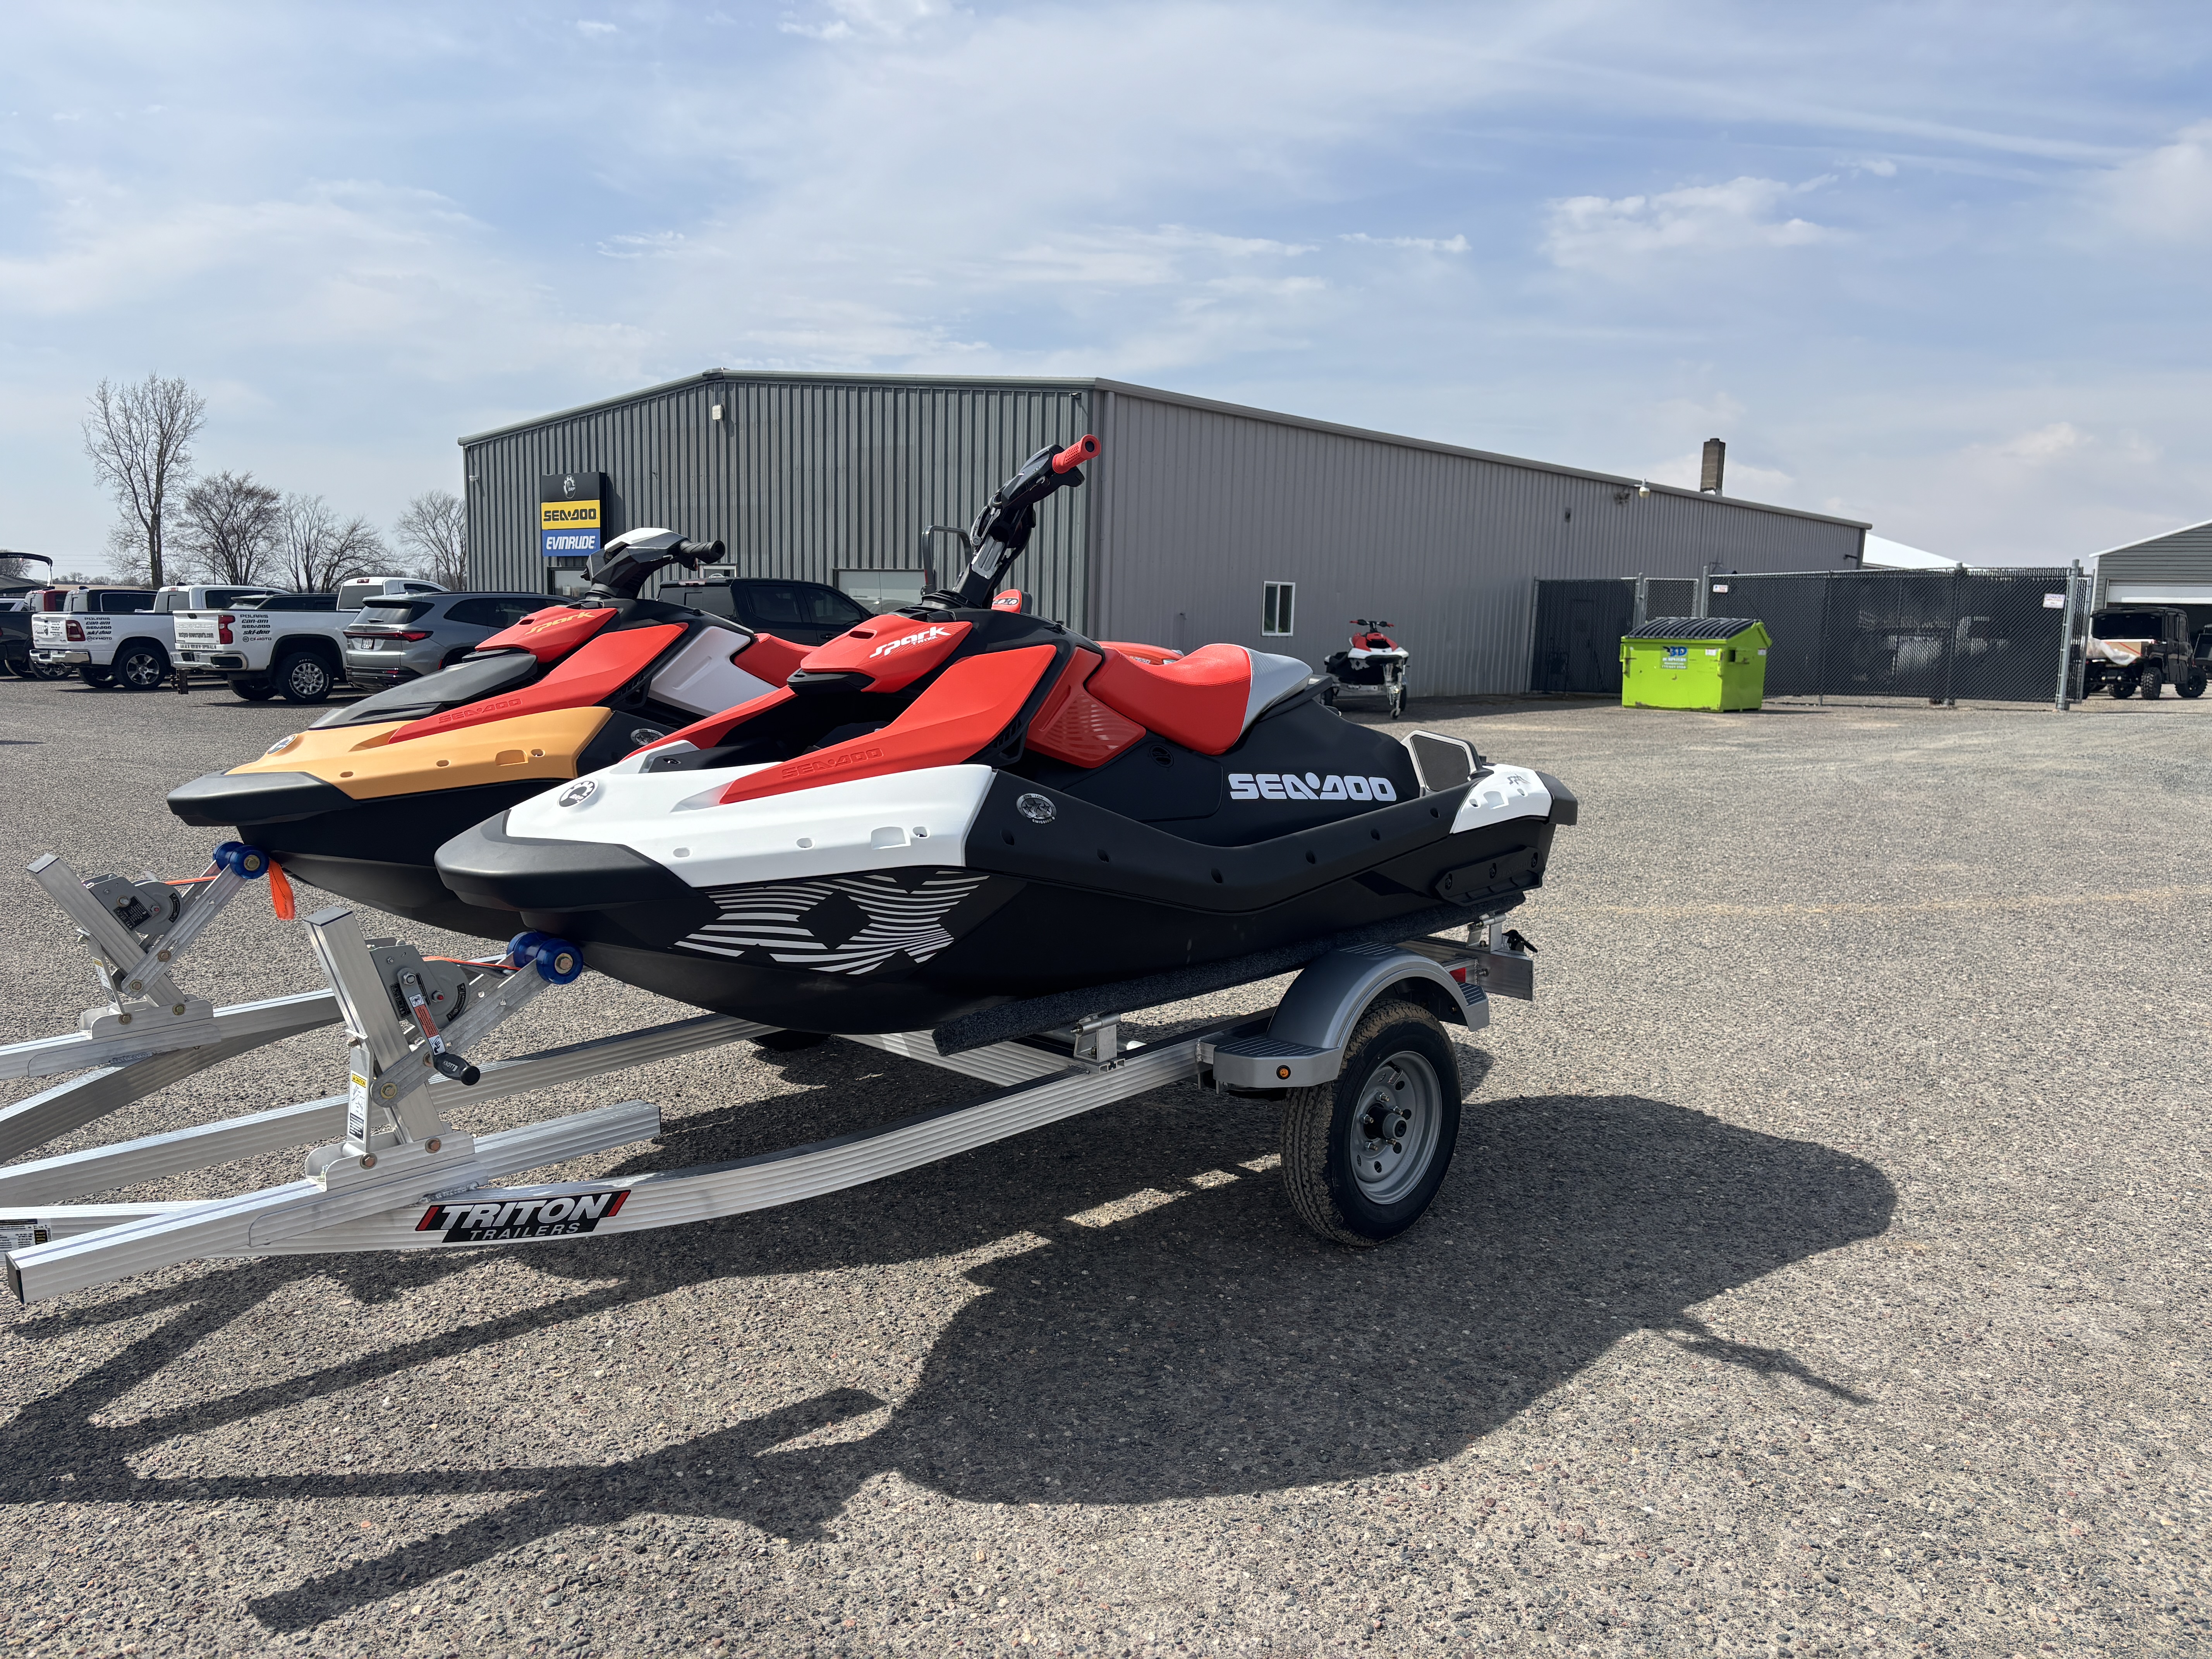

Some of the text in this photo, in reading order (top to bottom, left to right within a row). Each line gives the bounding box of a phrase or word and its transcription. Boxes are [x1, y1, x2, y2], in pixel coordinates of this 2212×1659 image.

[546, 536, 596, 550] EVINRUDE
[911, 635, 938, 646] TRIXX
[443, 1060, 455, 1070] KNOTT
[440, 1193, 612, 1230] TRITON
[469, 1222, 580, 1240] TRAILERS
